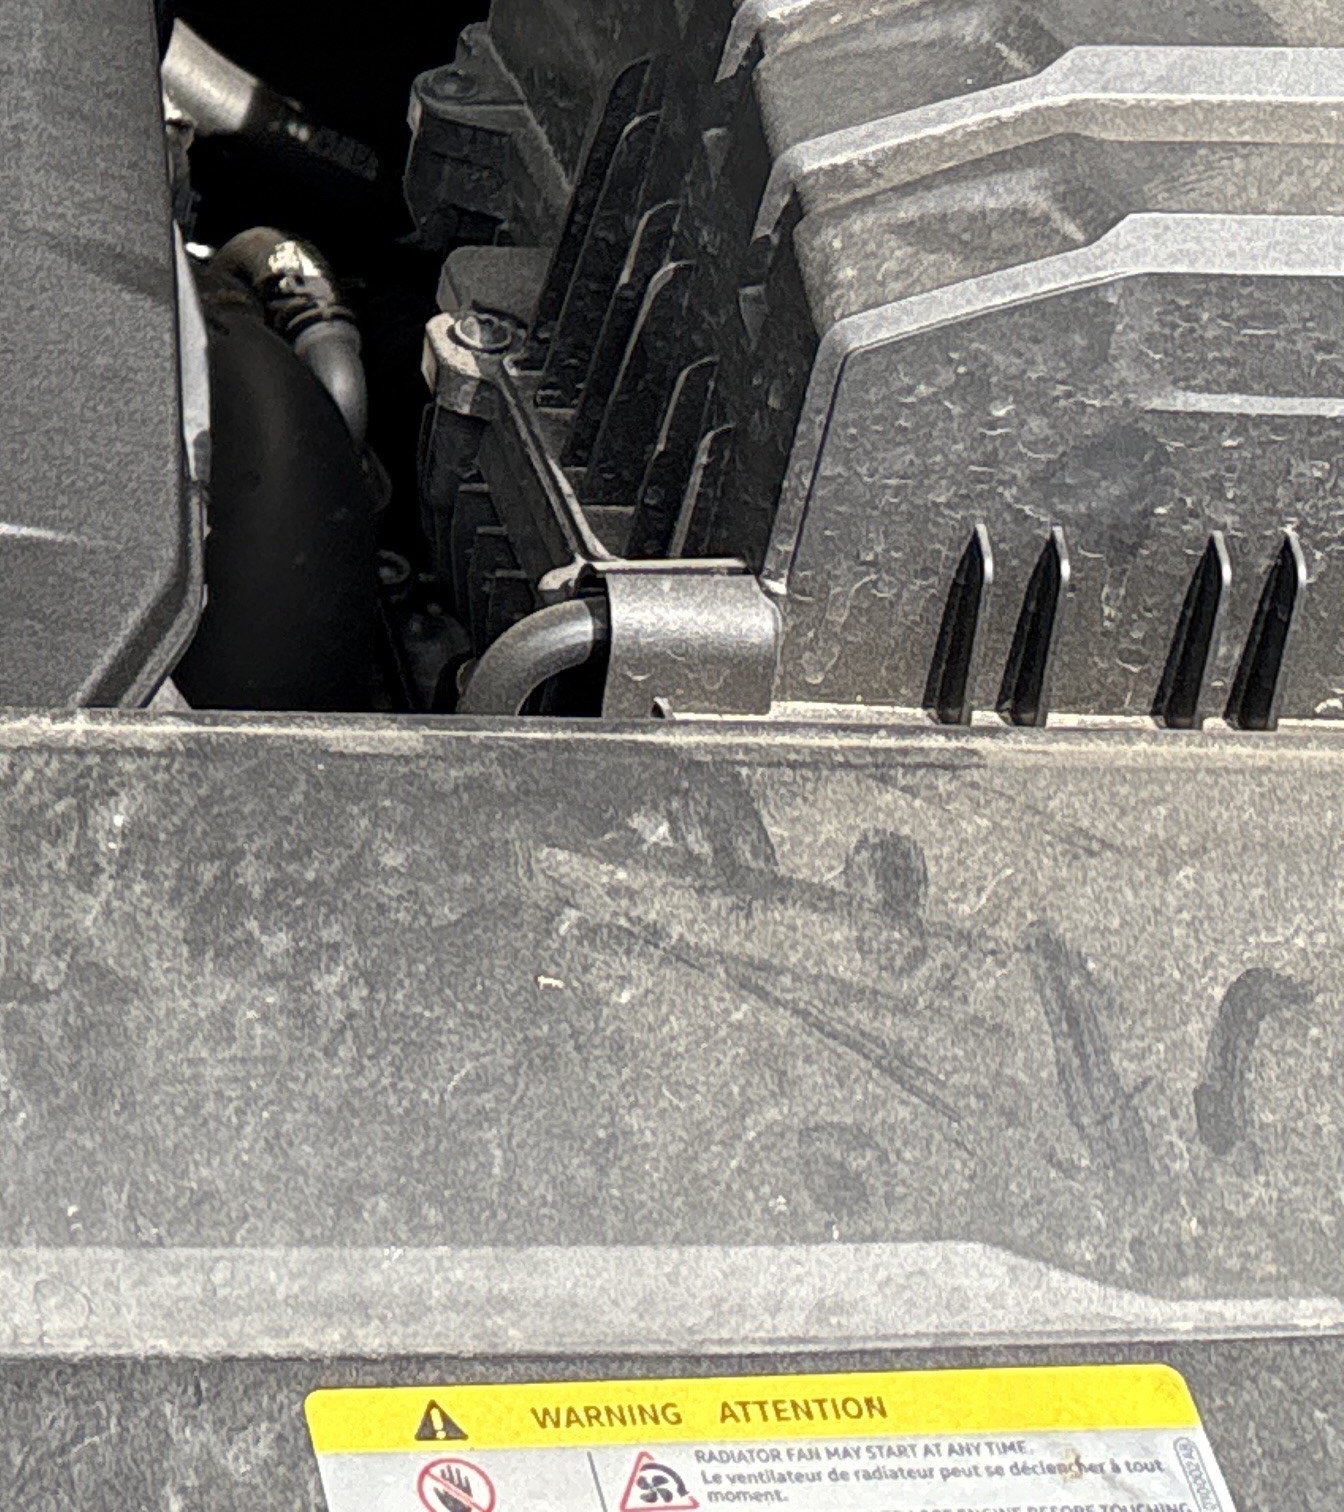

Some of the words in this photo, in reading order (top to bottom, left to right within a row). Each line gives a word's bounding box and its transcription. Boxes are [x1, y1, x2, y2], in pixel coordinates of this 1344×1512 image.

[529, 1402, 683, 1430] WARNING
[718, 1395, 888, 1424] ATTENTION
[693, 1447, 783, 1464] RADIATOR
[785, 1446, 822, 1462] FAN
[824, 1445, 862, 1461] MAY
[864, 1443, 917, 1460] START
[923, 1442, 943, 1458] AT
[947, 1441, 981, 1457] ANY
[700, 1469, 723, 1485] Le
[725, 1468, 824, 1486] ventilateur
[827, 1467, 851, 1483] de
[853, 1464, 935, 1482] radiateur
[939, 1464, 983, 1482] peut
[984, 1465, 1006, 1478] se
[1109, 1457, 1122, 1474] à
[1124, 1459, 1166, 1474] tout
[706, 1488, 790, 1503] moment.
